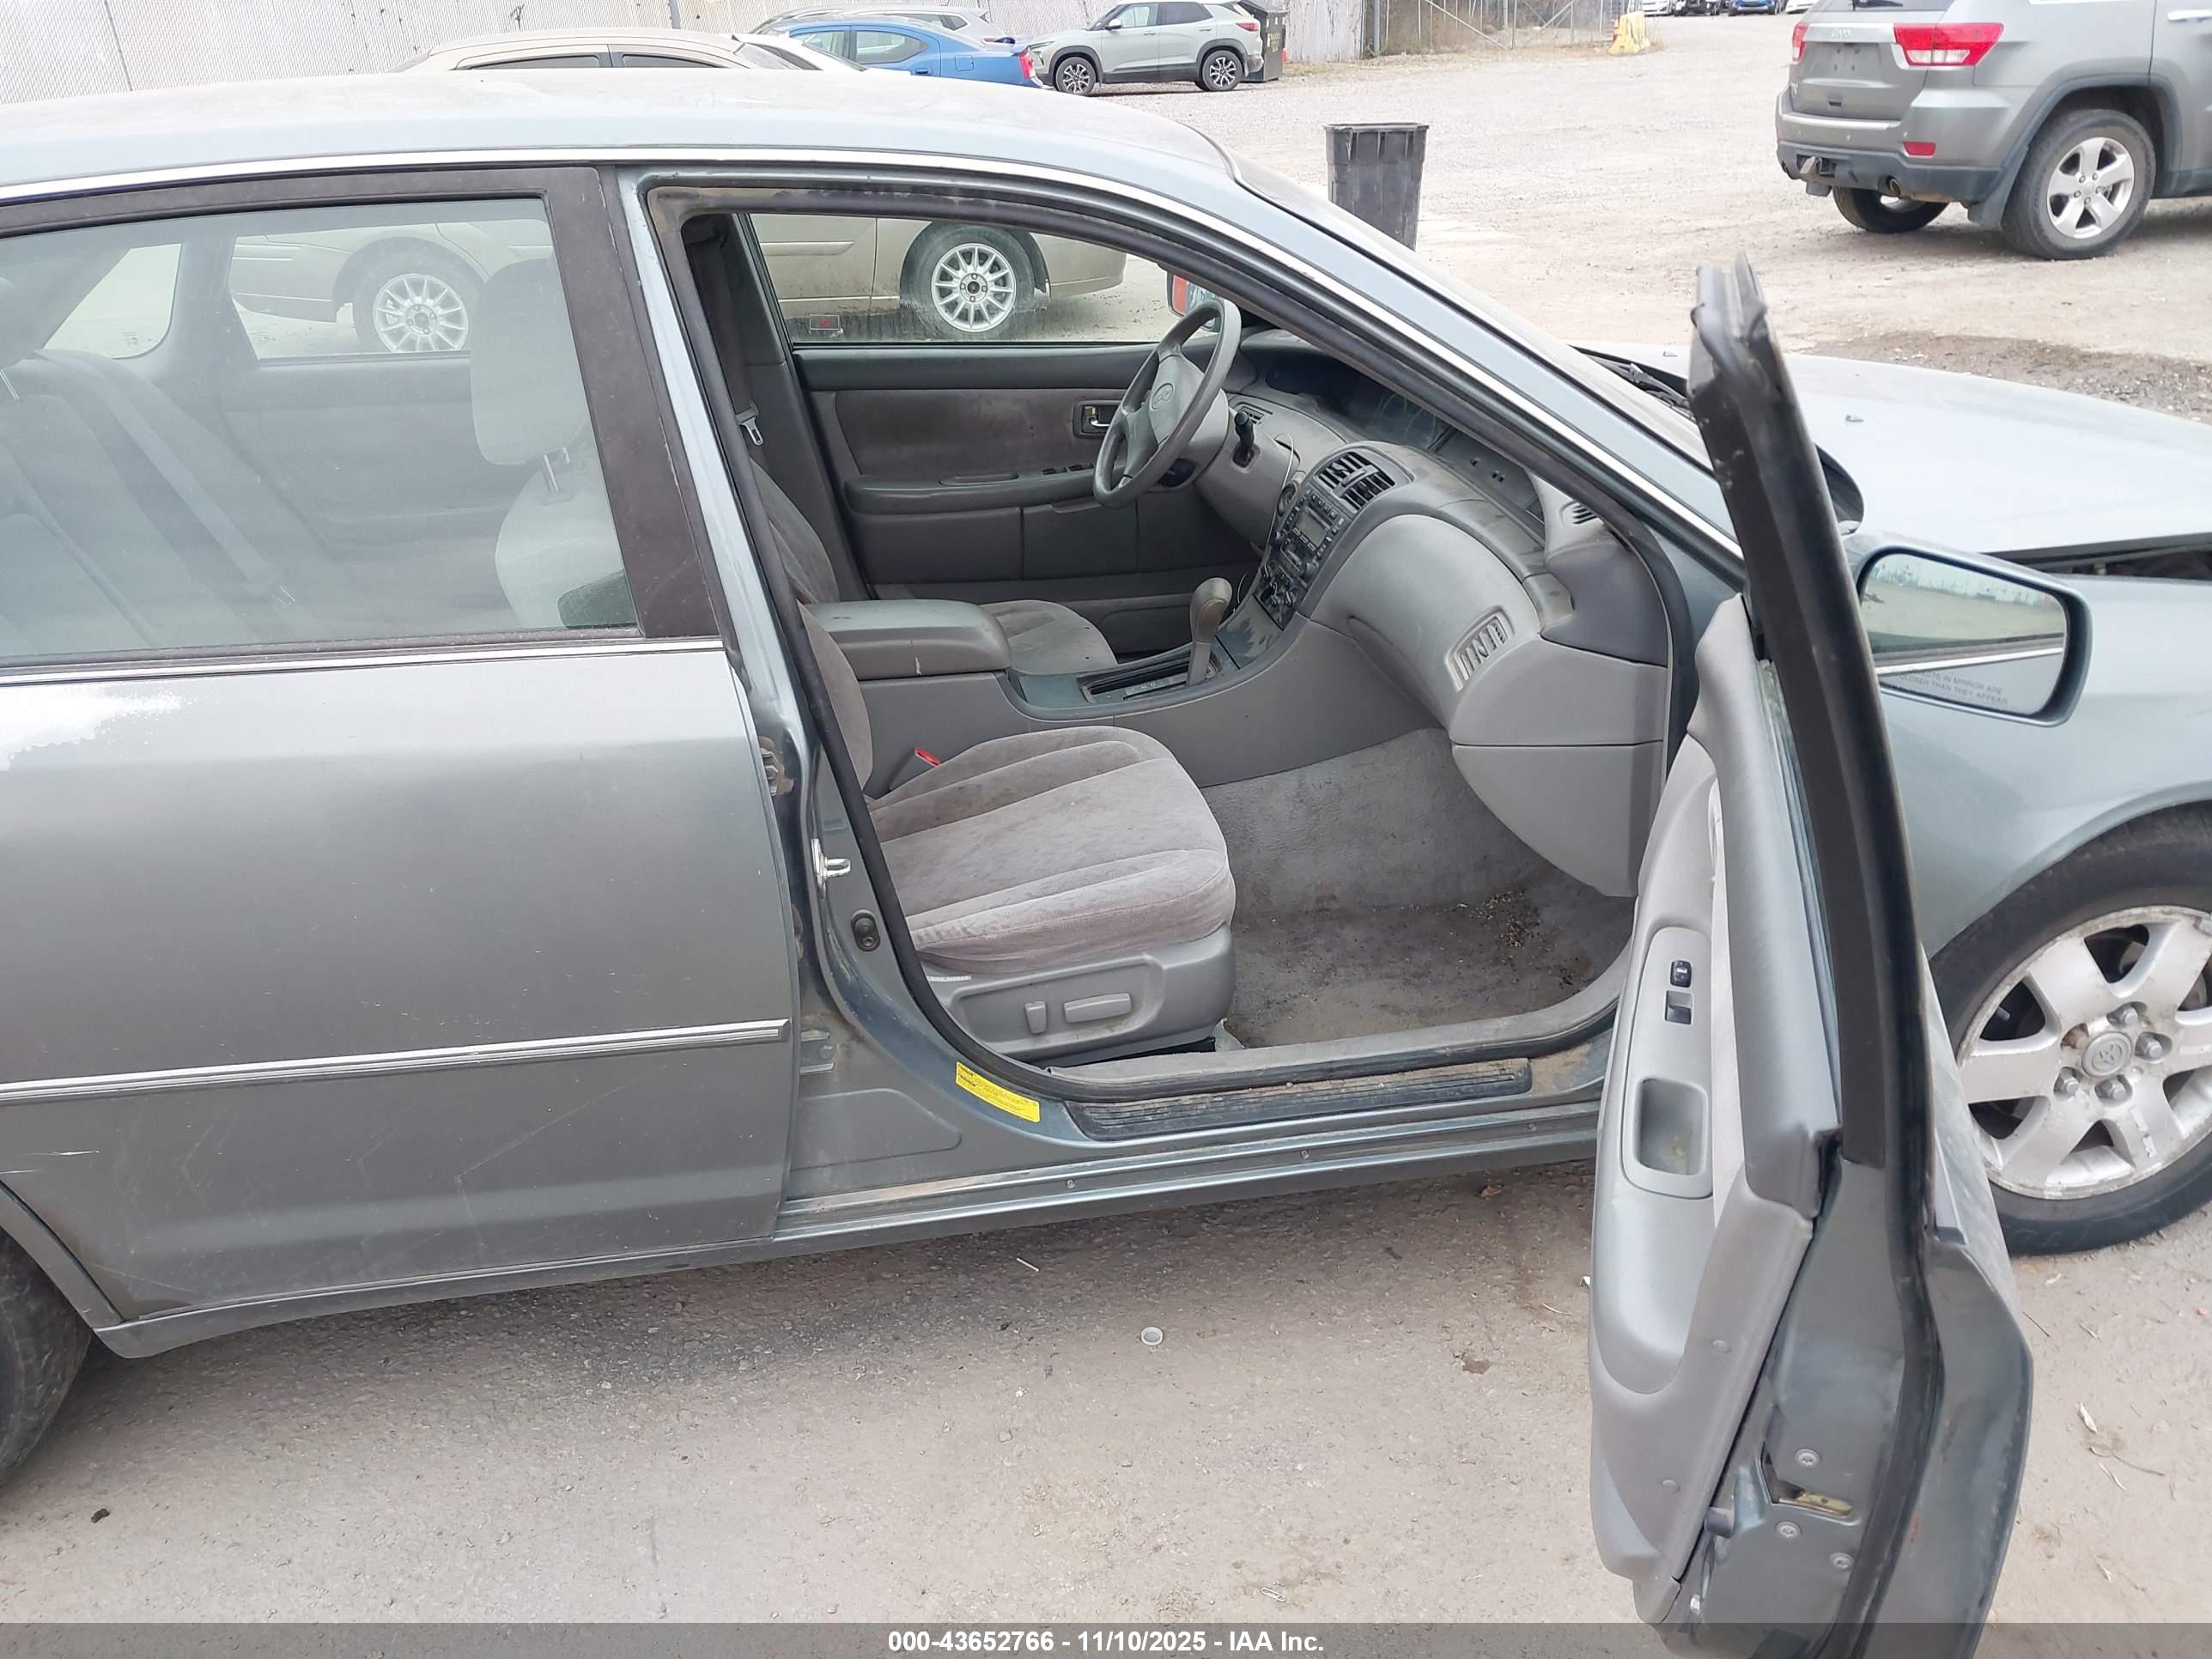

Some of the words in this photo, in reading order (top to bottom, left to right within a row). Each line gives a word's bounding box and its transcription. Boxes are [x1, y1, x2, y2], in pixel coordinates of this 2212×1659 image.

[1931, 681, 1952, 692] THAN
[1954, 686, 1972, 696] THEY
[1976, 692, 2008, 704] APPEAR
[1986, 685, 2002, 696] ARE
